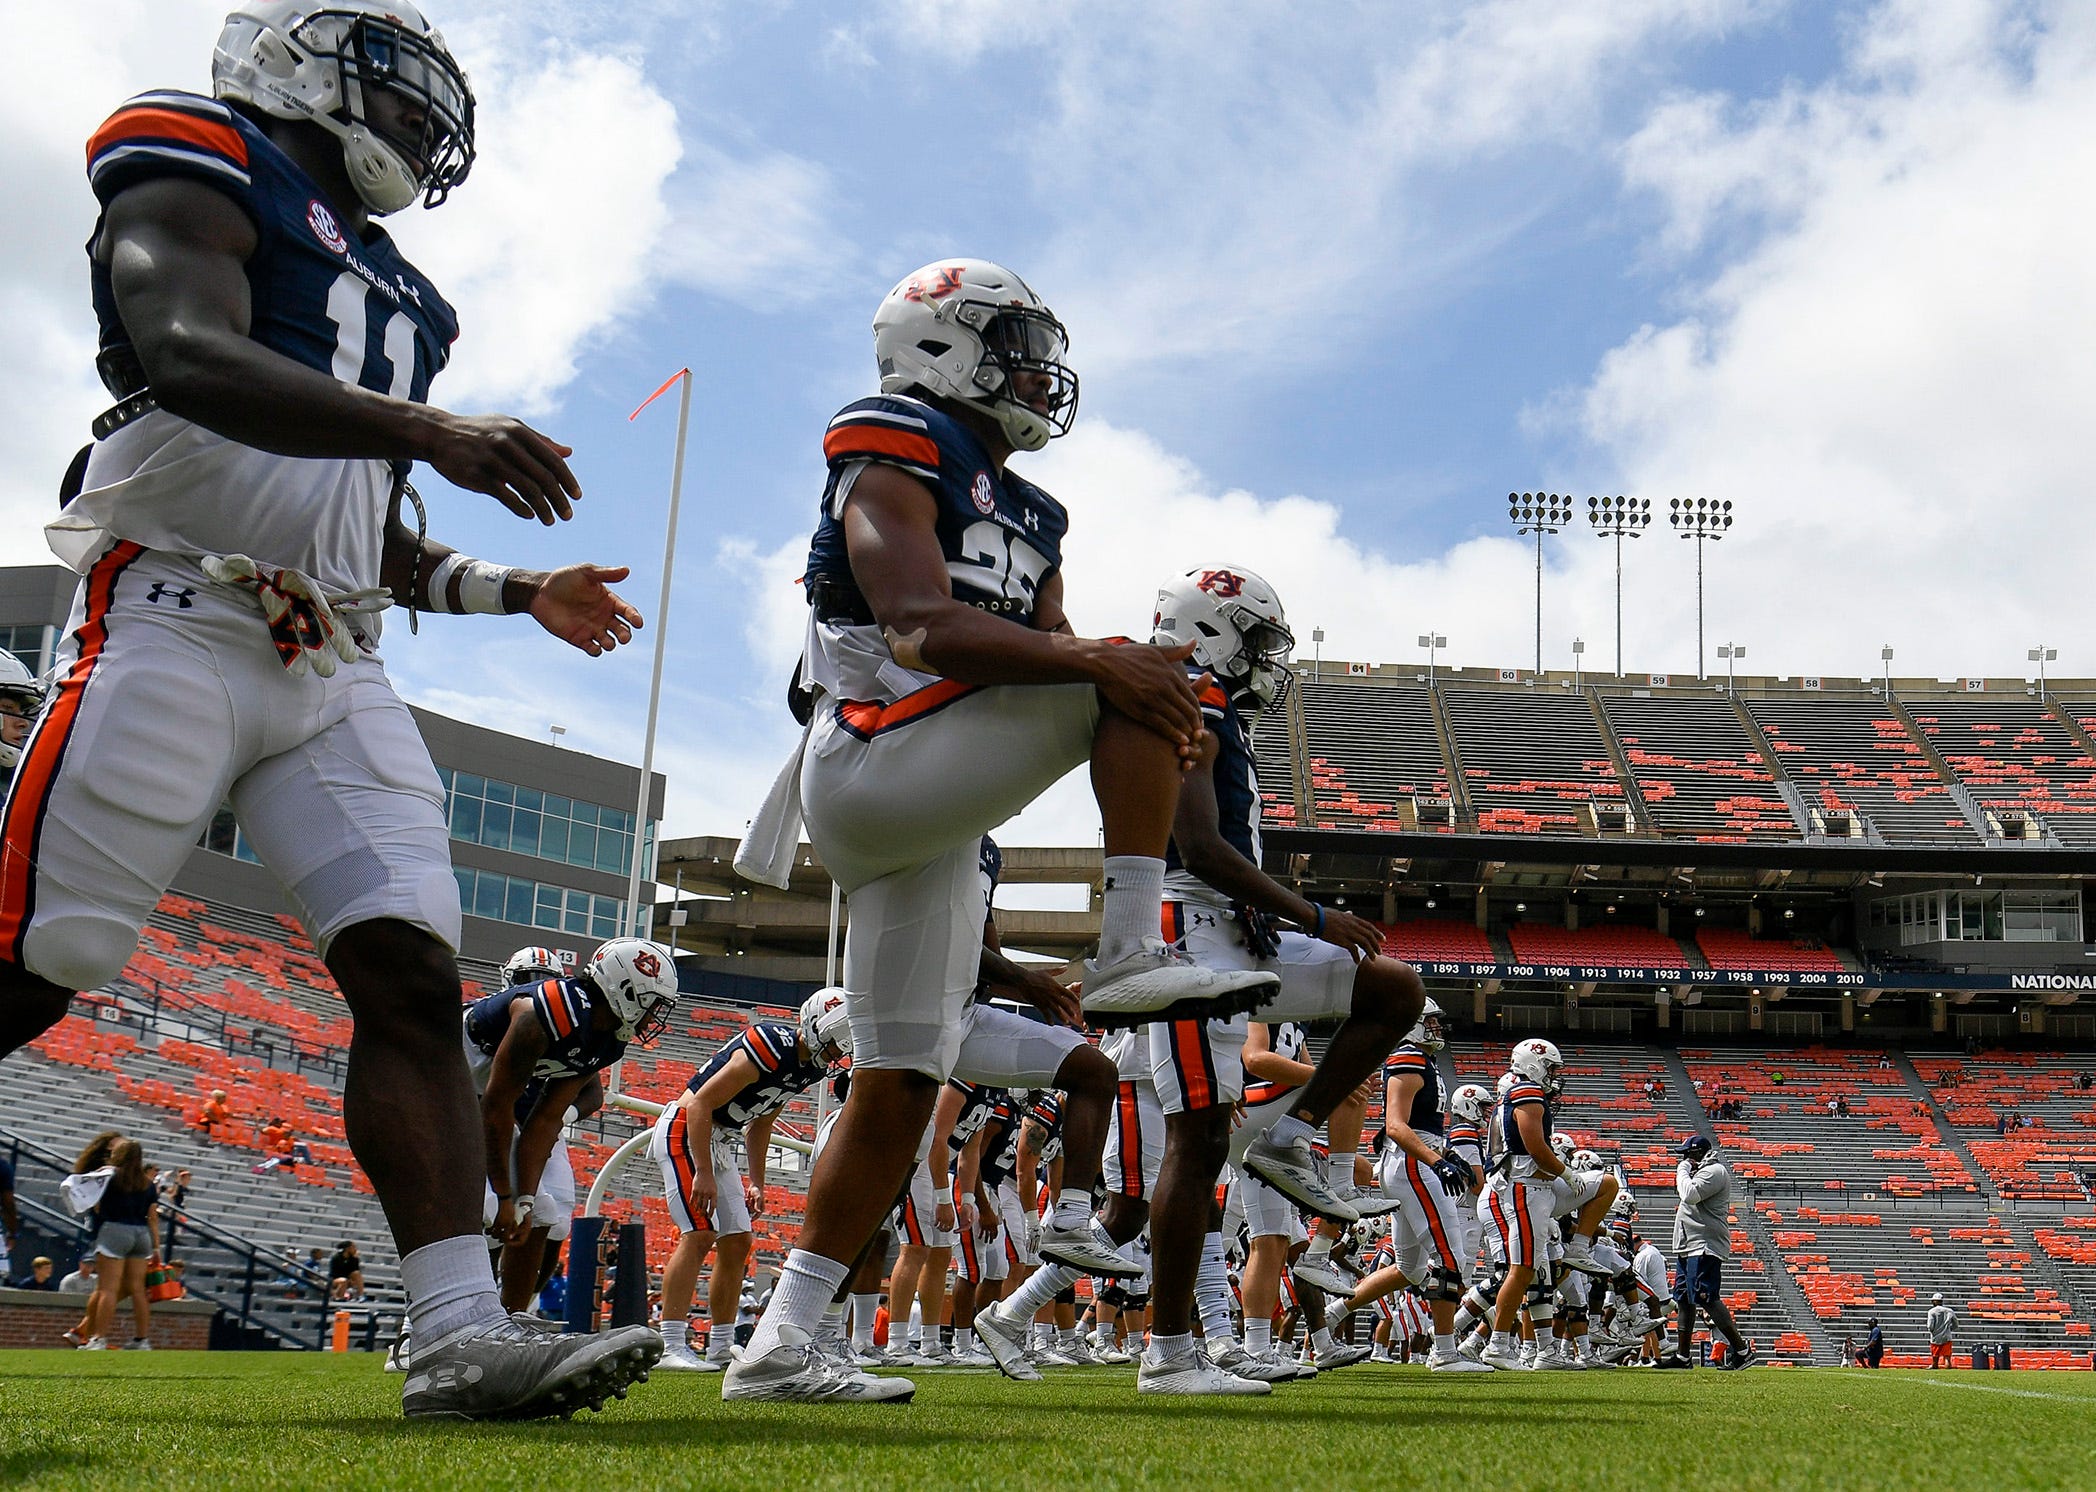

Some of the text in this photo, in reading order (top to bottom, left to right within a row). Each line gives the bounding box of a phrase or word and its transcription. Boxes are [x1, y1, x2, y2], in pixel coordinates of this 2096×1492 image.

[290, 96, 315, 115] TIGERS
[311, 202, 338, 240] SEC
[346, 252, 400, 304] AUBURN
[326, 270, 418, 401] 11
[976, 473, 991, 503] SEC
[948, 520, 1052, 614] 25
[1352, 664, 1364, 673] 61
[1502, 671, 1515, 680] 60
[1652, 676, 1665, 685] 59
[1805, 679, 1818, 688] 58
[1969, 680, 1982, 689] 57
[559, 951, 573, 964] 13
[1432, 963, 1460, 974] 1893
[1469, 964, 1497, 975] 1897
[1506, 965, 1534, 977] 1900
[1543, 966, 1571, 977] 1904
[1580, 967, 1607, 978] 1913
[1617, 968, 1645, 979] 1914
[1654, 969, 1681, 980] 1932
[1690, 970, 1718, 981] 1957
[1727, 971, 1754, 983] 1958
[1764, 972, 1791, 983] 1993
[1799, 973, 1827, 984] 2004
[1836, 974, 1864, 985] 2010
